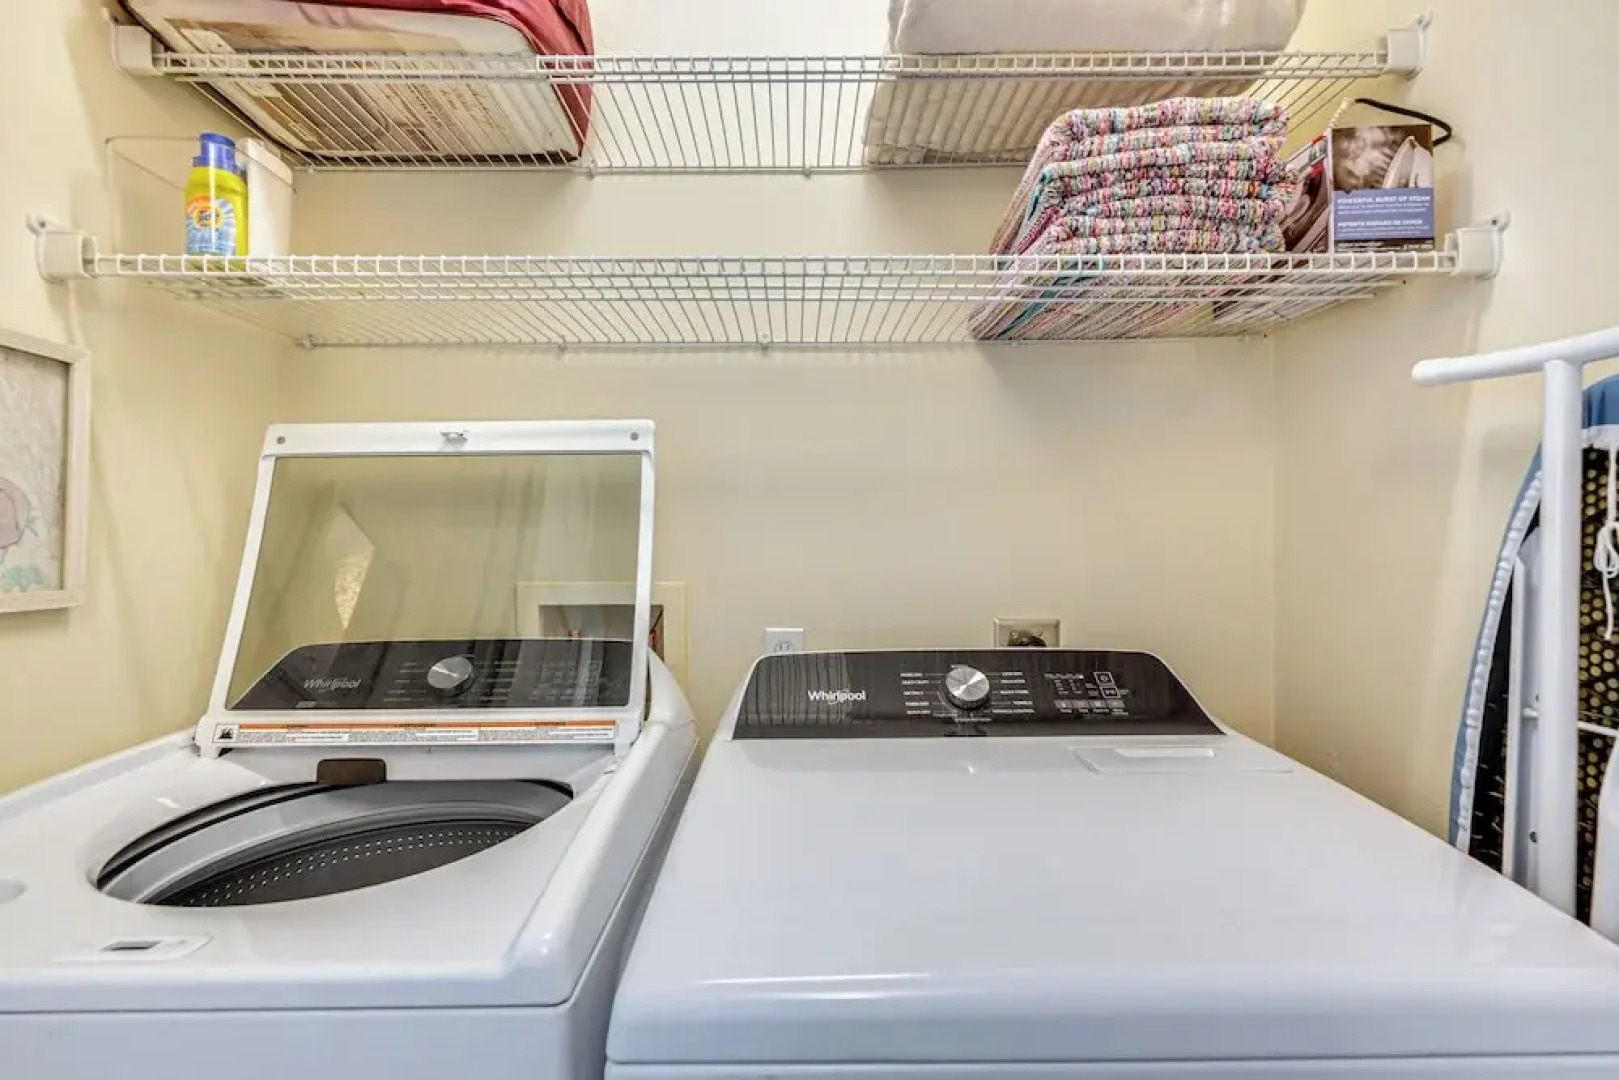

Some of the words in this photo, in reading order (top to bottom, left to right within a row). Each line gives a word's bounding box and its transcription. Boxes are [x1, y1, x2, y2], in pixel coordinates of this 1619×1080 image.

[1375, 195, 1397, 203] BURST
[303, 676, 362, 691] Whirlpool
[807, 689, 867, 704] Whirlpool
